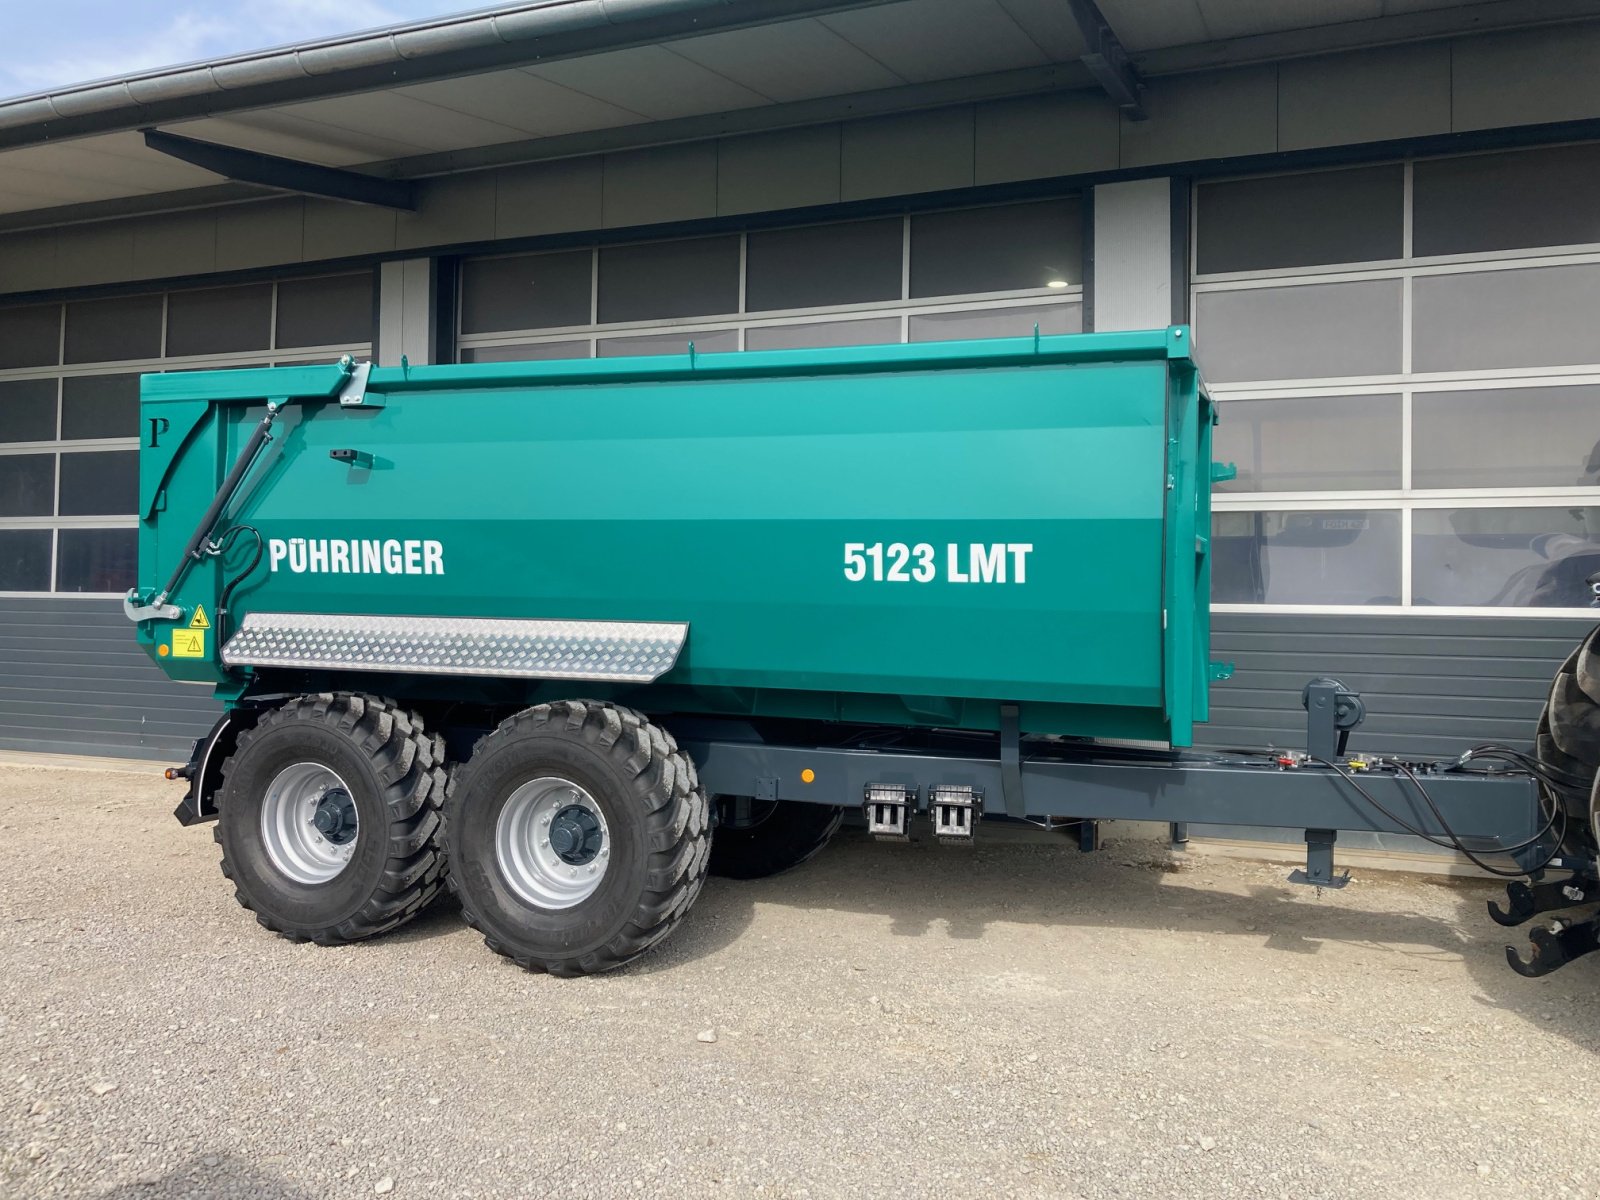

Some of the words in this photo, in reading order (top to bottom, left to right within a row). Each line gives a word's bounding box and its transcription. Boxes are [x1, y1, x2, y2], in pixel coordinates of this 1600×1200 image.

[148, 417, 170, 448] P
[268, 538, 445, 575] PÜHRINGER
[843, 542, 936, 583] 5123
[947, 543, 1034, 584] LMT
